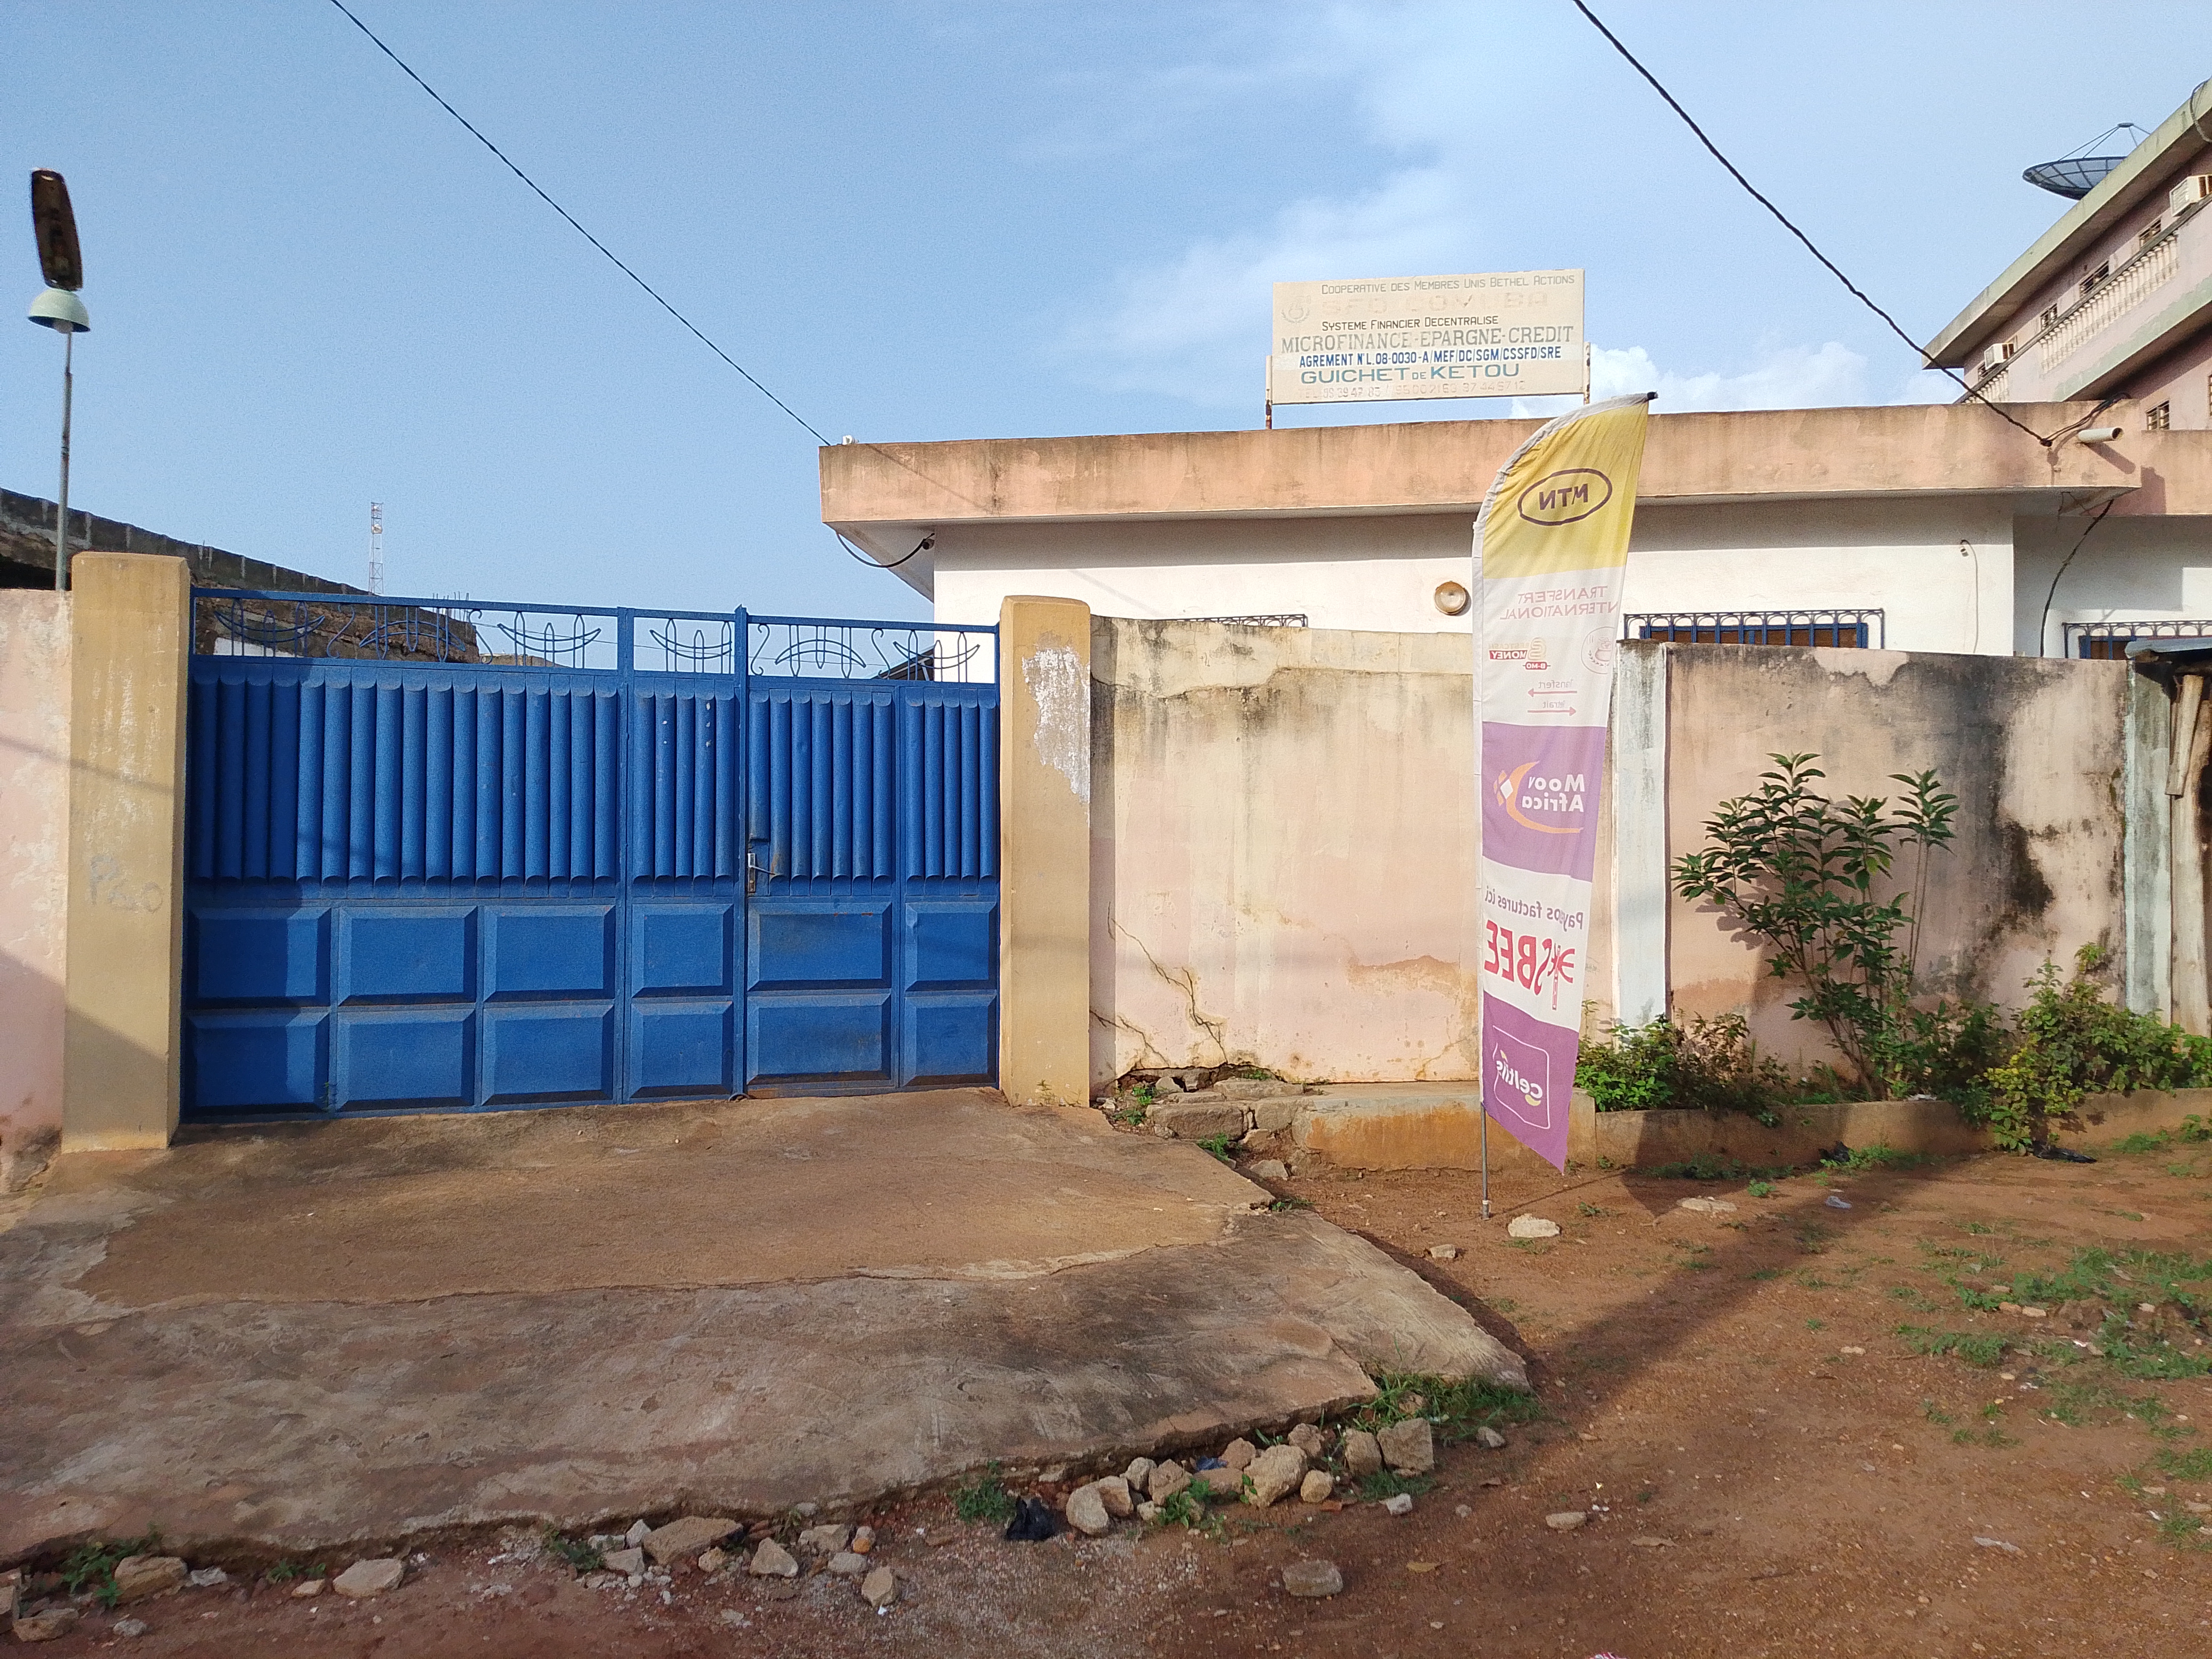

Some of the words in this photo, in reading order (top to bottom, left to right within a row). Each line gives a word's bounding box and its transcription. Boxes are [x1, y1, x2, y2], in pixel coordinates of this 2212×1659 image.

[1321, 283, 1387, 295] COOPERATIVE
[1390, 282, 1410, 292] DES
[1414, 280, 1460, 291] MEMBRES
[1464, 278, 1486, 288] UNIS
[1489, 277, 1529, 288] BETHEL
[1533, 275, 1575, 286] ACTIONS
[1322, 321, 1367, 331] SYSTEME
[1370, 319, 1420, 330] FINANCIER
[1424, 315, 1499, 328] DECENTRALISE
[1299, 353, 1354, 368] AGREMENT
[1301, 367, 1411, 384] GUICHET
[1412, 371, 1427, 380] DE
[1430, 363, 1519, 380] KETOU
